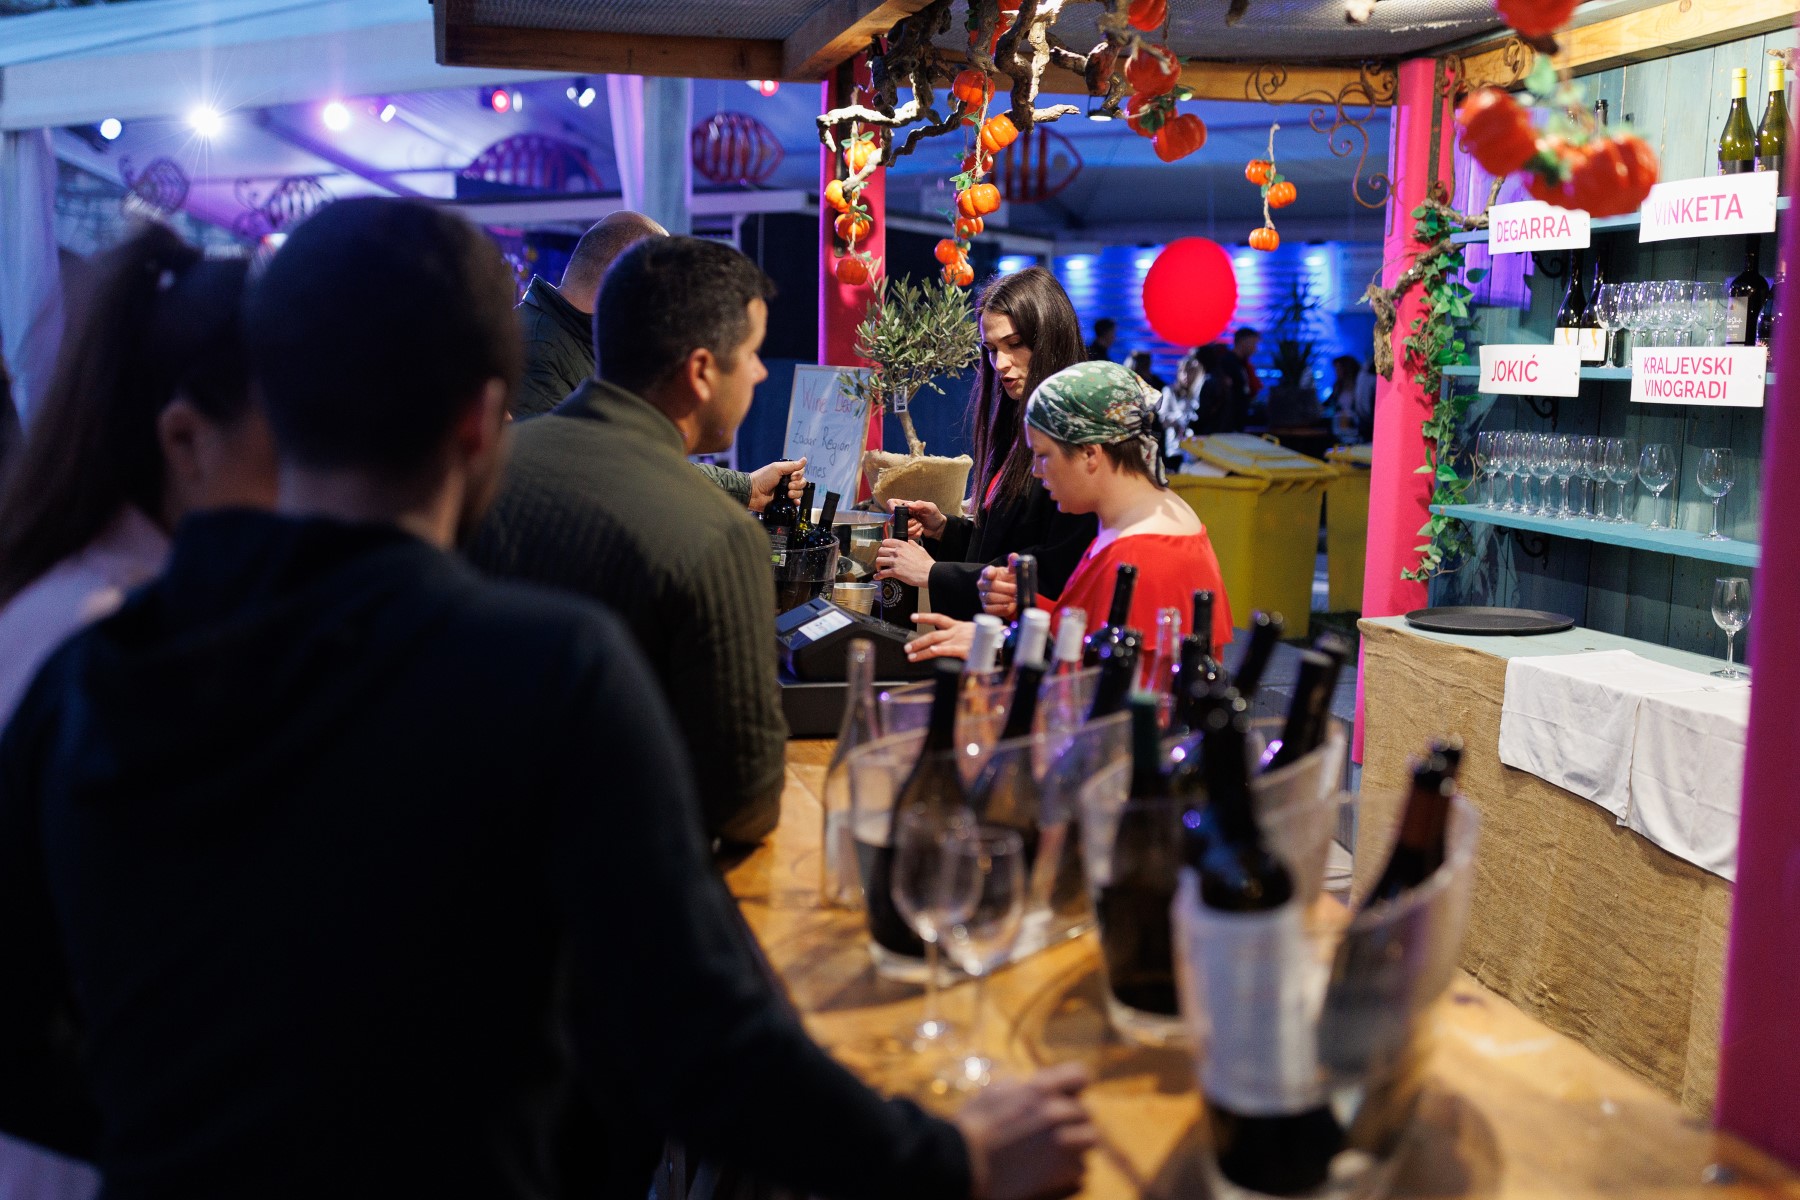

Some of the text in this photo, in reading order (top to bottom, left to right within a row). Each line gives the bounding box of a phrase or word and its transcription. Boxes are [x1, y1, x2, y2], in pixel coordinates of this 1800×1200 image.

[1654, 193, 1744, 226] VINKETA
[1496, 214, 1571, 243] DEGARRA
[1491, 354, 1539, 383] JOKIĆ
[1643, 356, 1733, 376] KRALJEVSKI
[802, 376, 828, 414] Wine
[1644, 379, 1727, 400] VINOGRADI
[821, 425, 850, 467] Region
